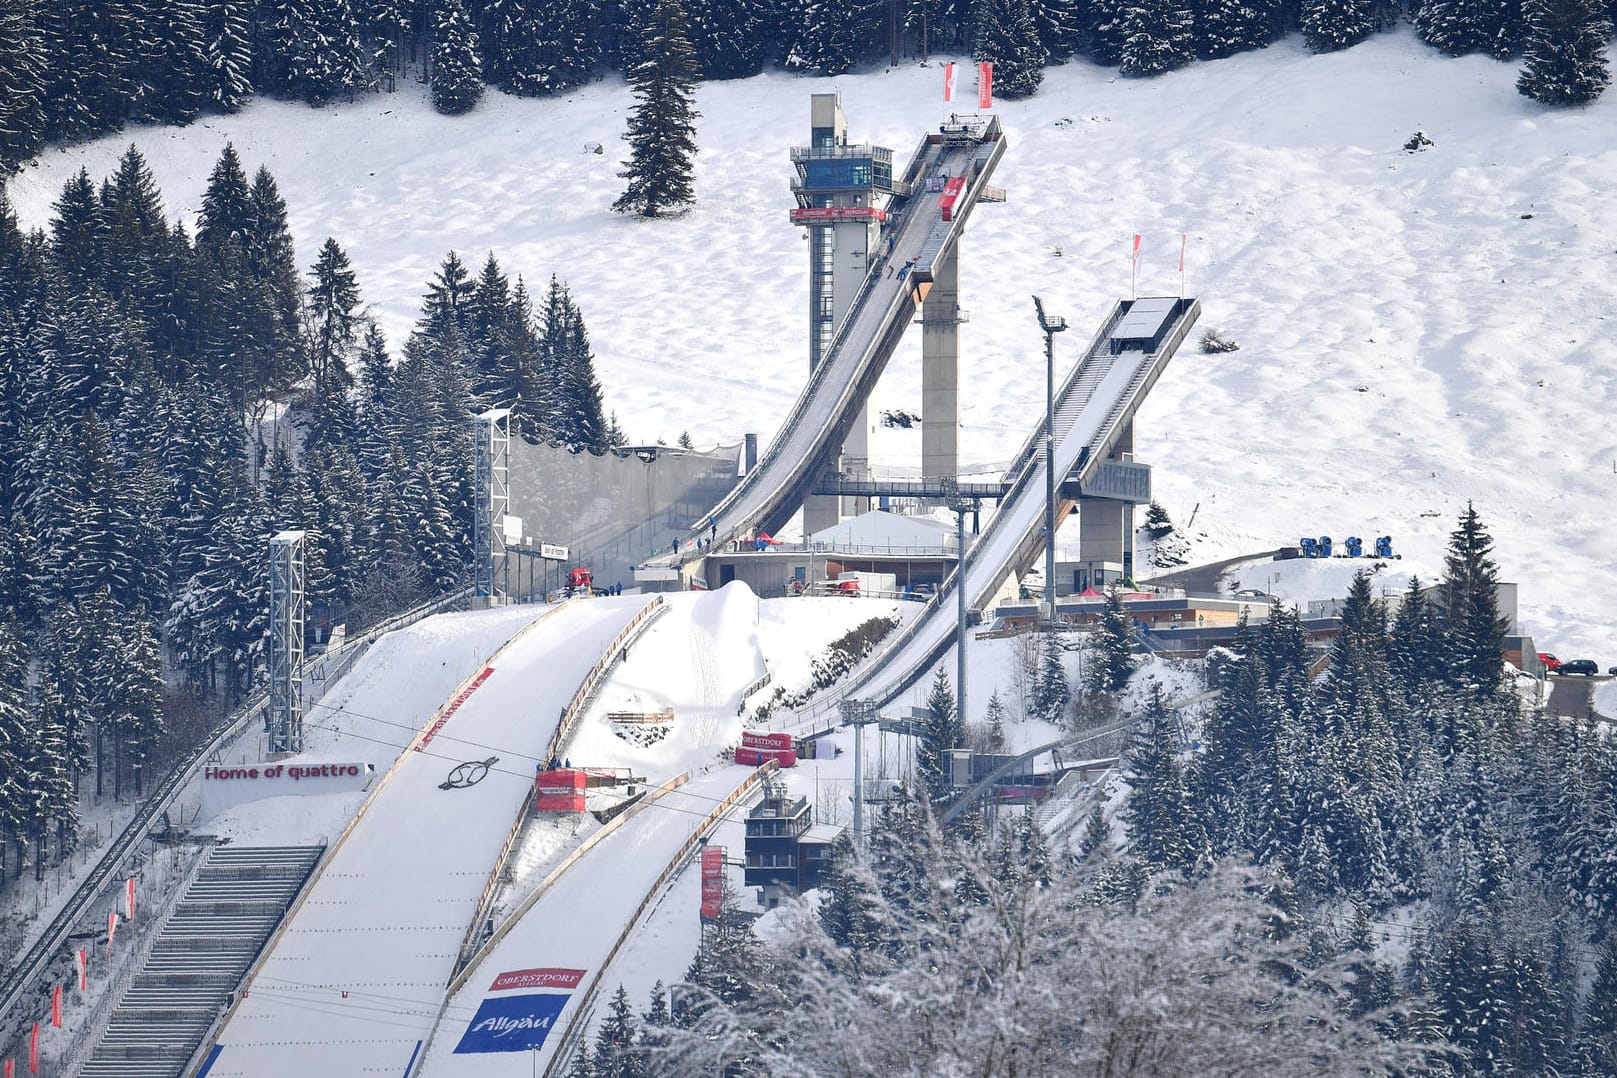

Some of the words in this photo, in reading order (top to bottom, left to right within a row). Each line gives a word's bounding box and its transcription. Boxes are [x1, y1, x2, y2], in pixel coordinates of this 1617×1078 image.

[205, 767, 259, 780] Home
[263, 765, 284, 778] of
[288, 765, 359, 780] quattro
[497, 974, 579, 985] OBERSTDORF
[472, 1014, 550, 1039] Allgäu
